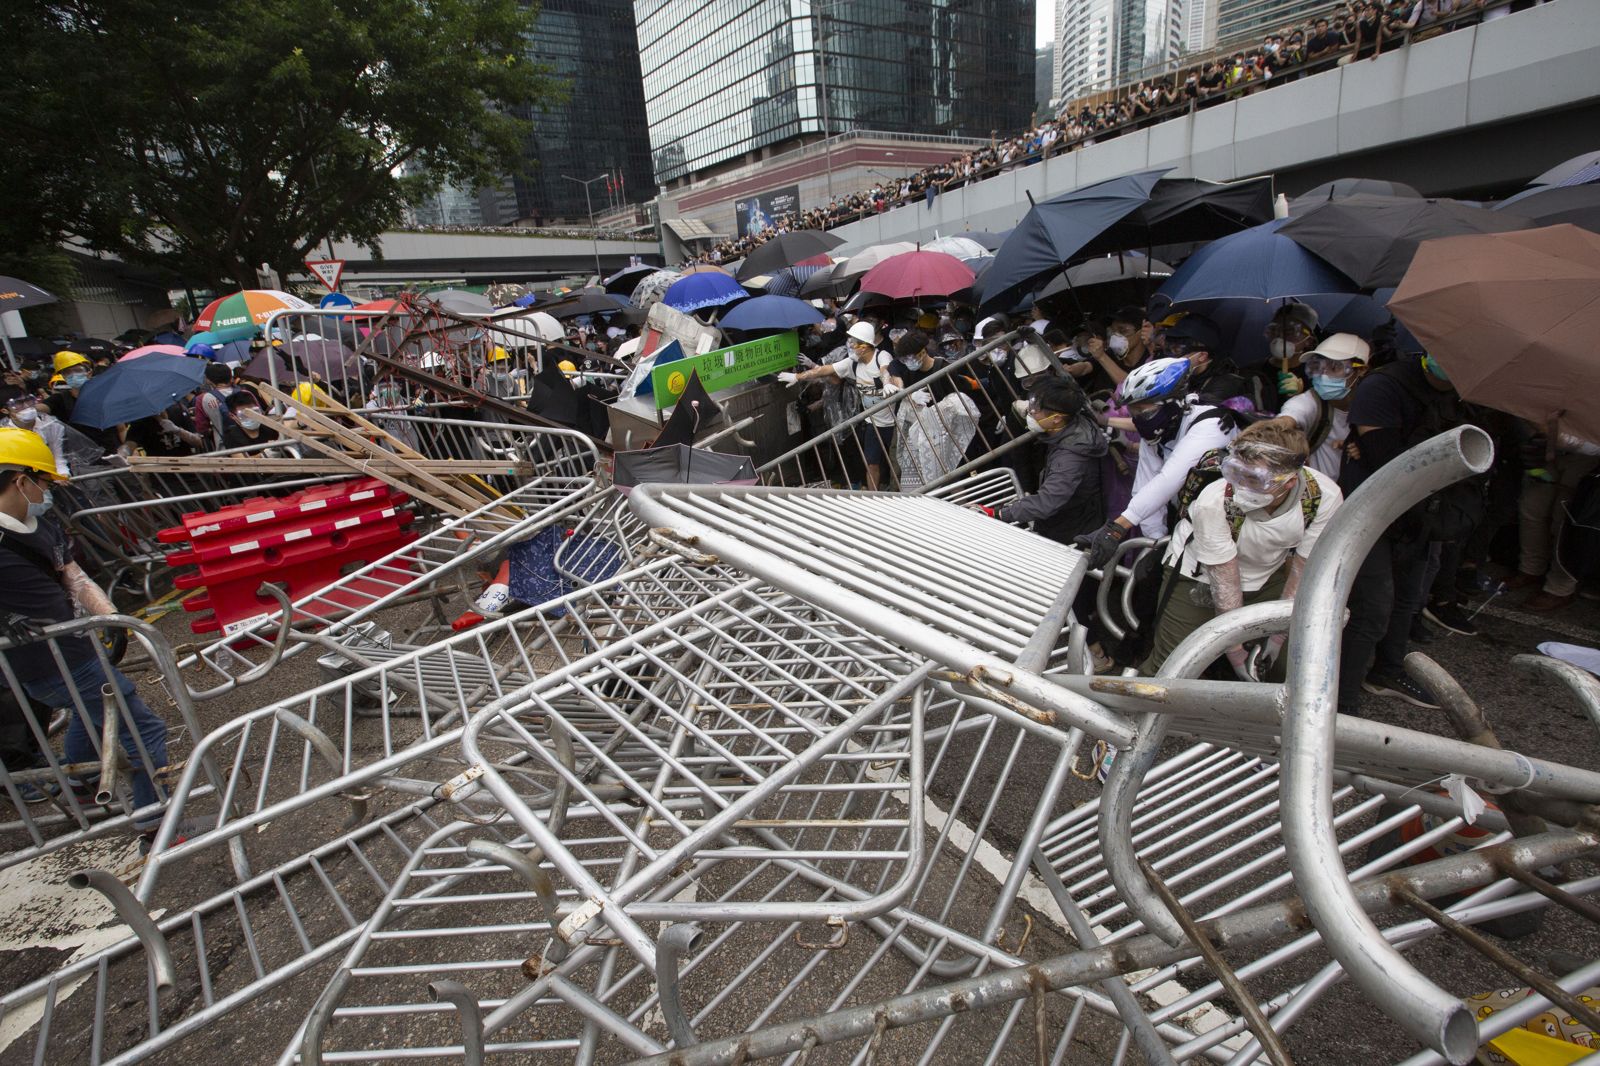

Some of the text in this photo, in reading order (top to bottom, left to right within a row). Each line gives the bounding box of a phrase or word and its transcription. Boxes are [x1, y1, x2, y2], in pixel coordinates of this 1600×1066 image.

[216, 316, 246, 327] 7-ELEVEN
[724, 361, 756, 375] RECYCLABLES
[756, 354, 783, 366] COLLECTION
